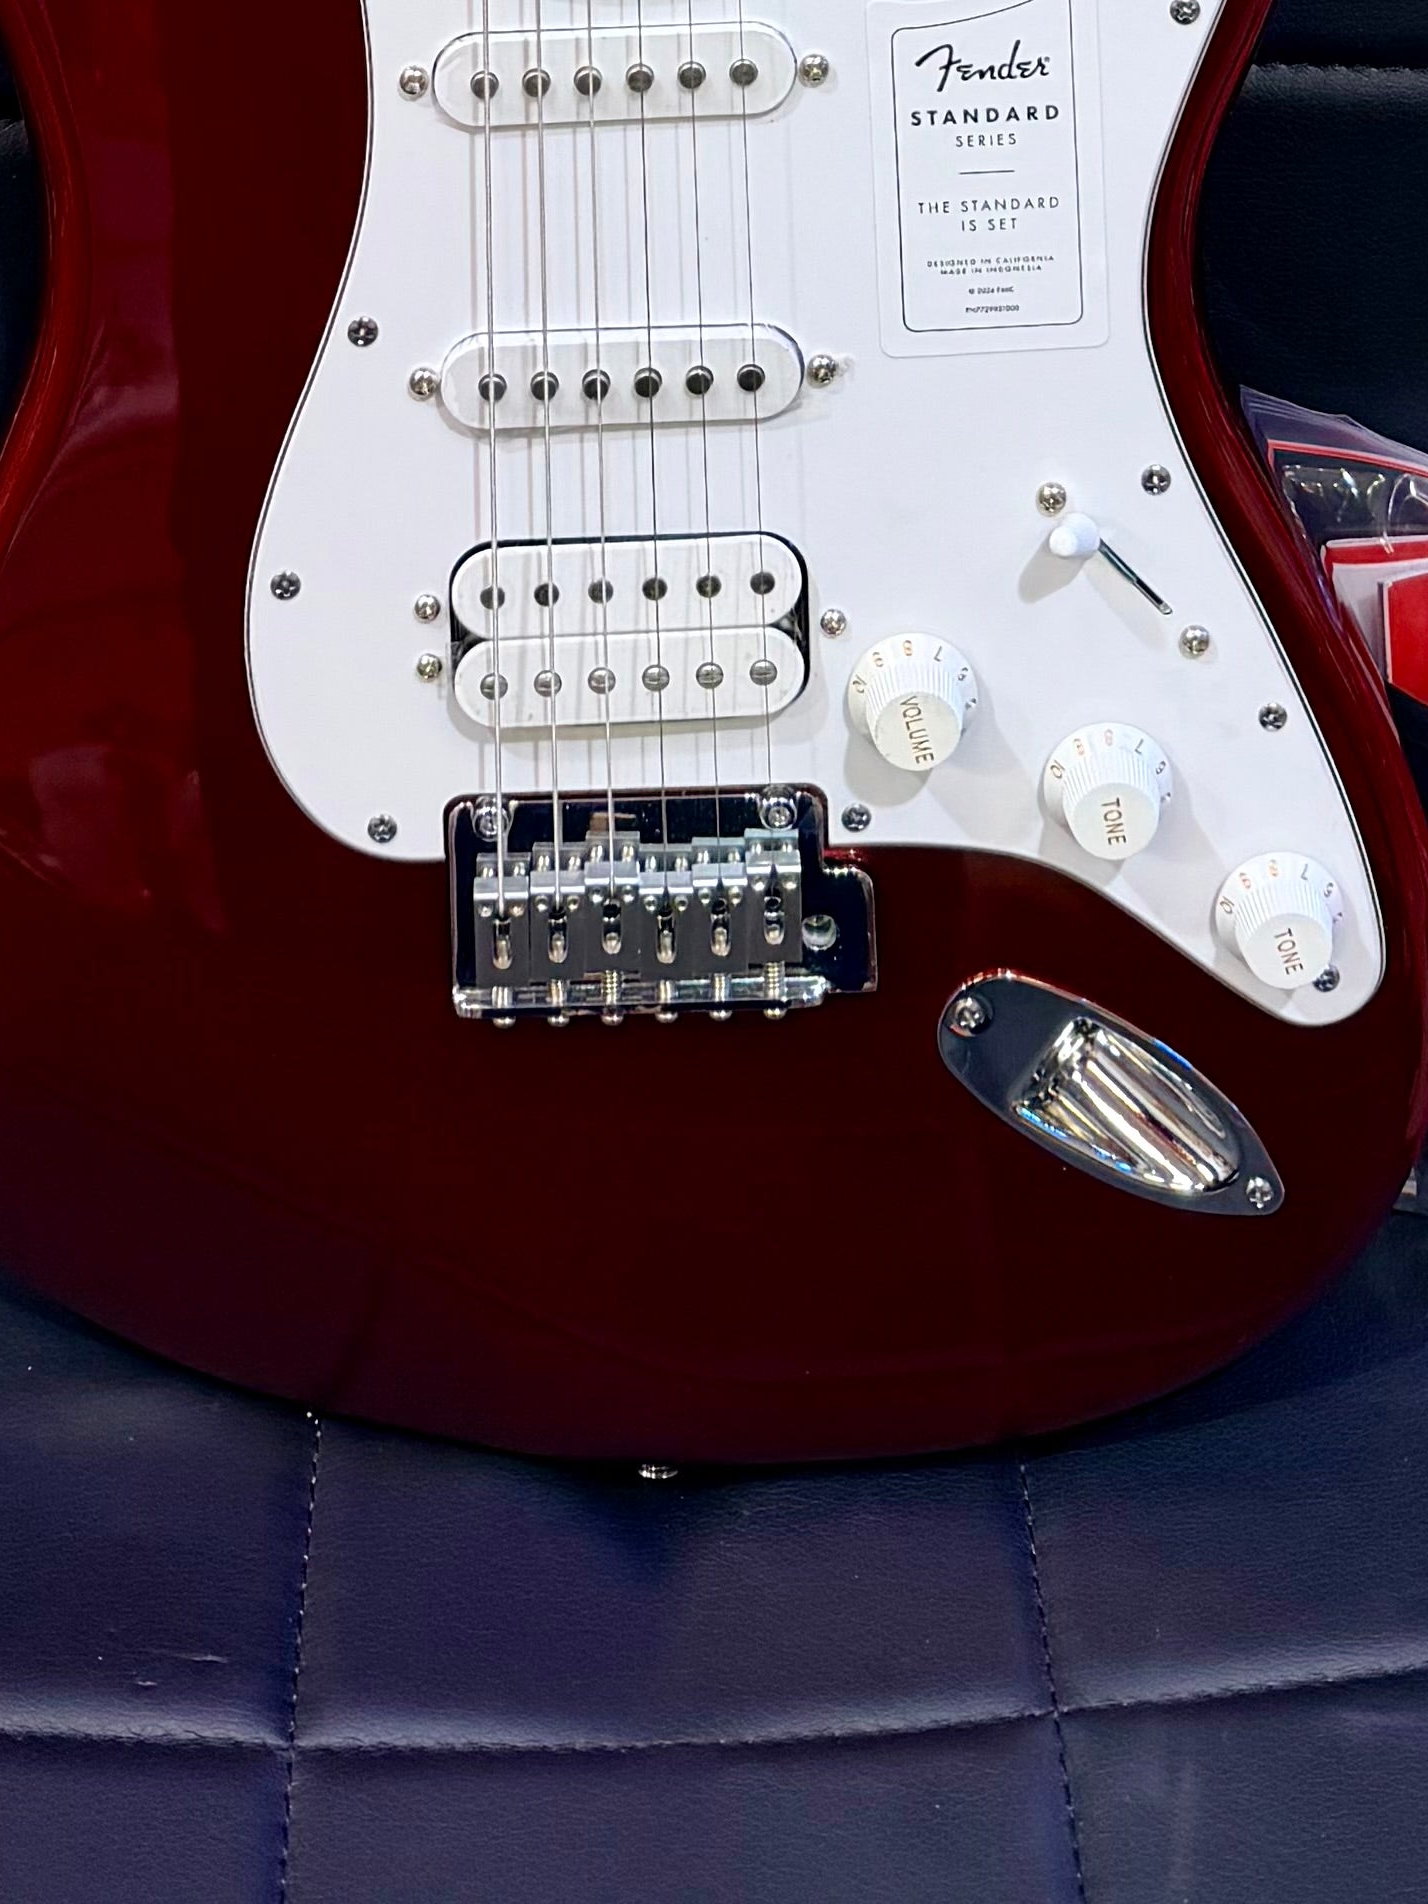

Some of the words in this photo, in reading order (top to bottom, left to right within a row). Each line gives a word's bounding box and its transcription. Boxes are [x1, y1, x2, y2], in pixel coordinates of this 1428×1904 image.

[910, 104, 1060, 127] STANDARD
[955, 132, 1017, 148] SERIES
[918, 200, 950, 215] THE
[961, 196, 1060, 212] STANDARD
[961, 220, 977, 232] IS
[988, 217, 1018, 231] SET
[900, 695, 935, 764] VOLUME
[1101, 797, 1127, 846] TONE
[1274, 927, 1304, 975] TONE
